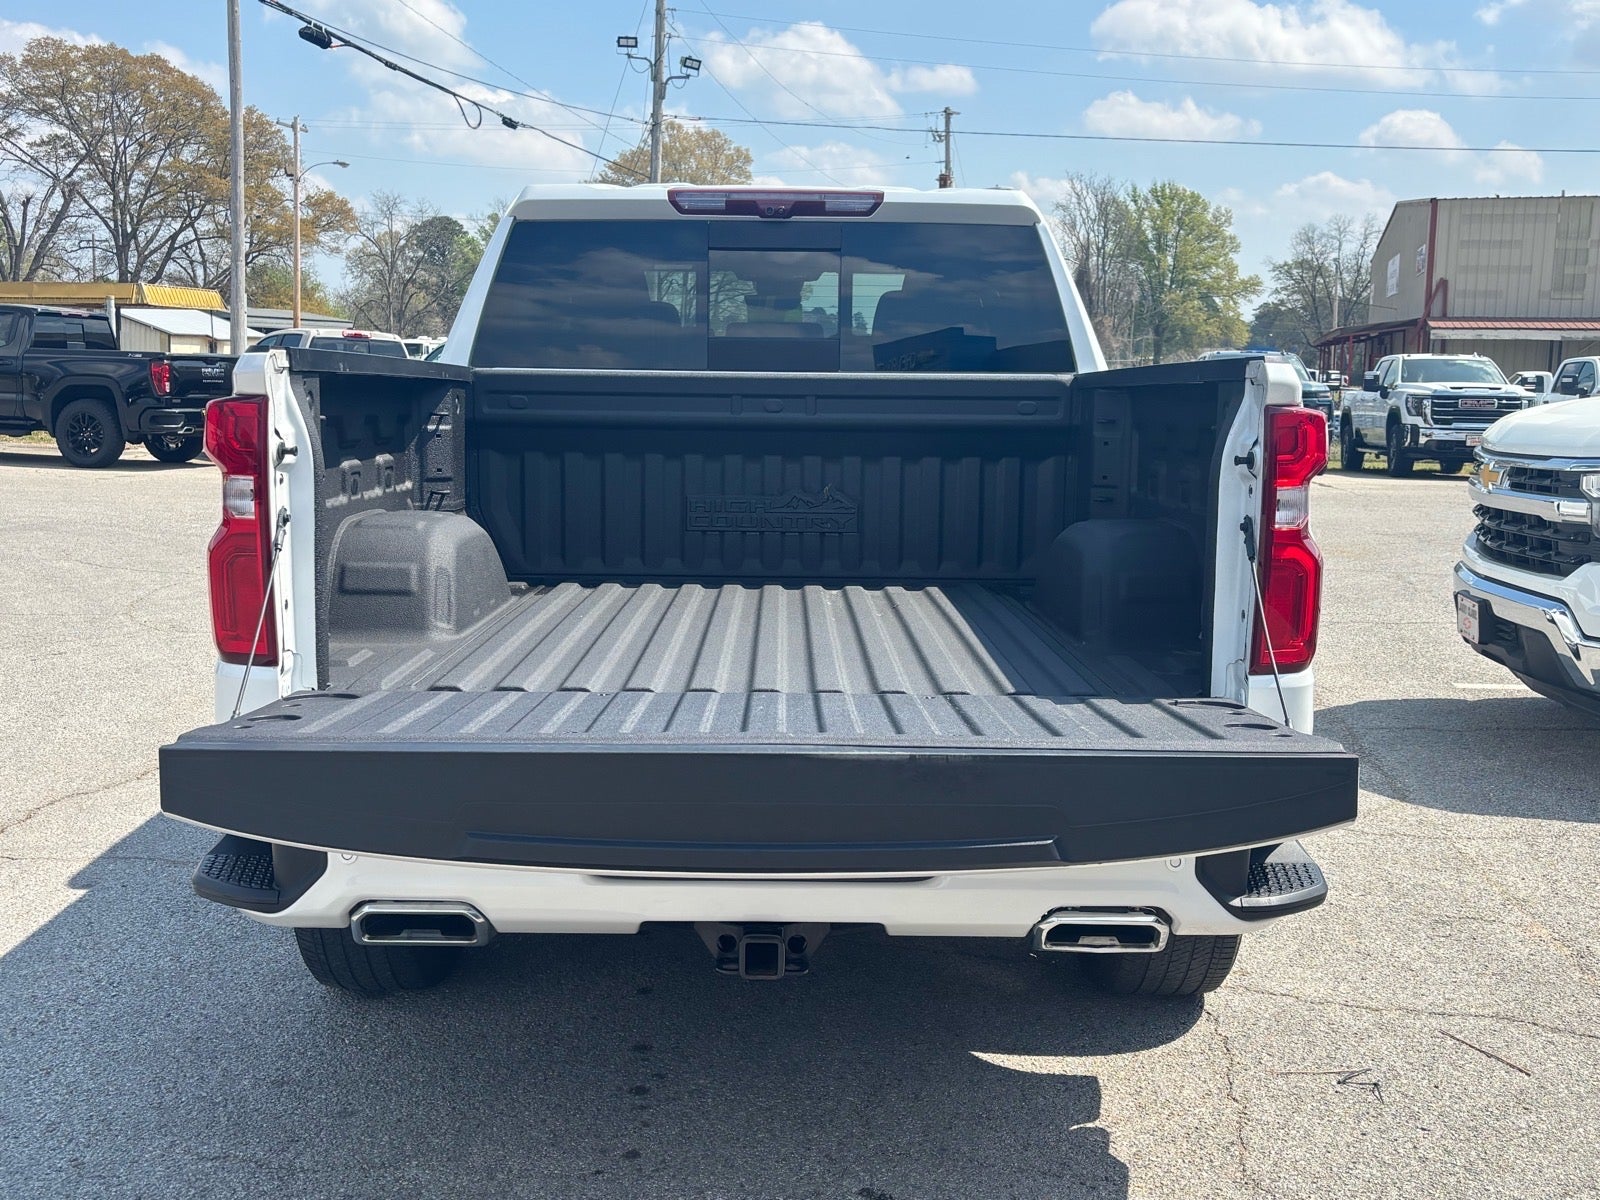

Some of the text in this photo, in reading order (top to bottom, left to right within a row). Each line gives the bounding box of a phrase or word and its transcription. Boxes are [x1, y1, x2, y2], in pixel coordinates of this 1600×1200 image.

[1460, 399, 1496, 408] GMC
[689, 500, 772, 513] HIGH
[689, 514, 856, 530] COUNTRY
